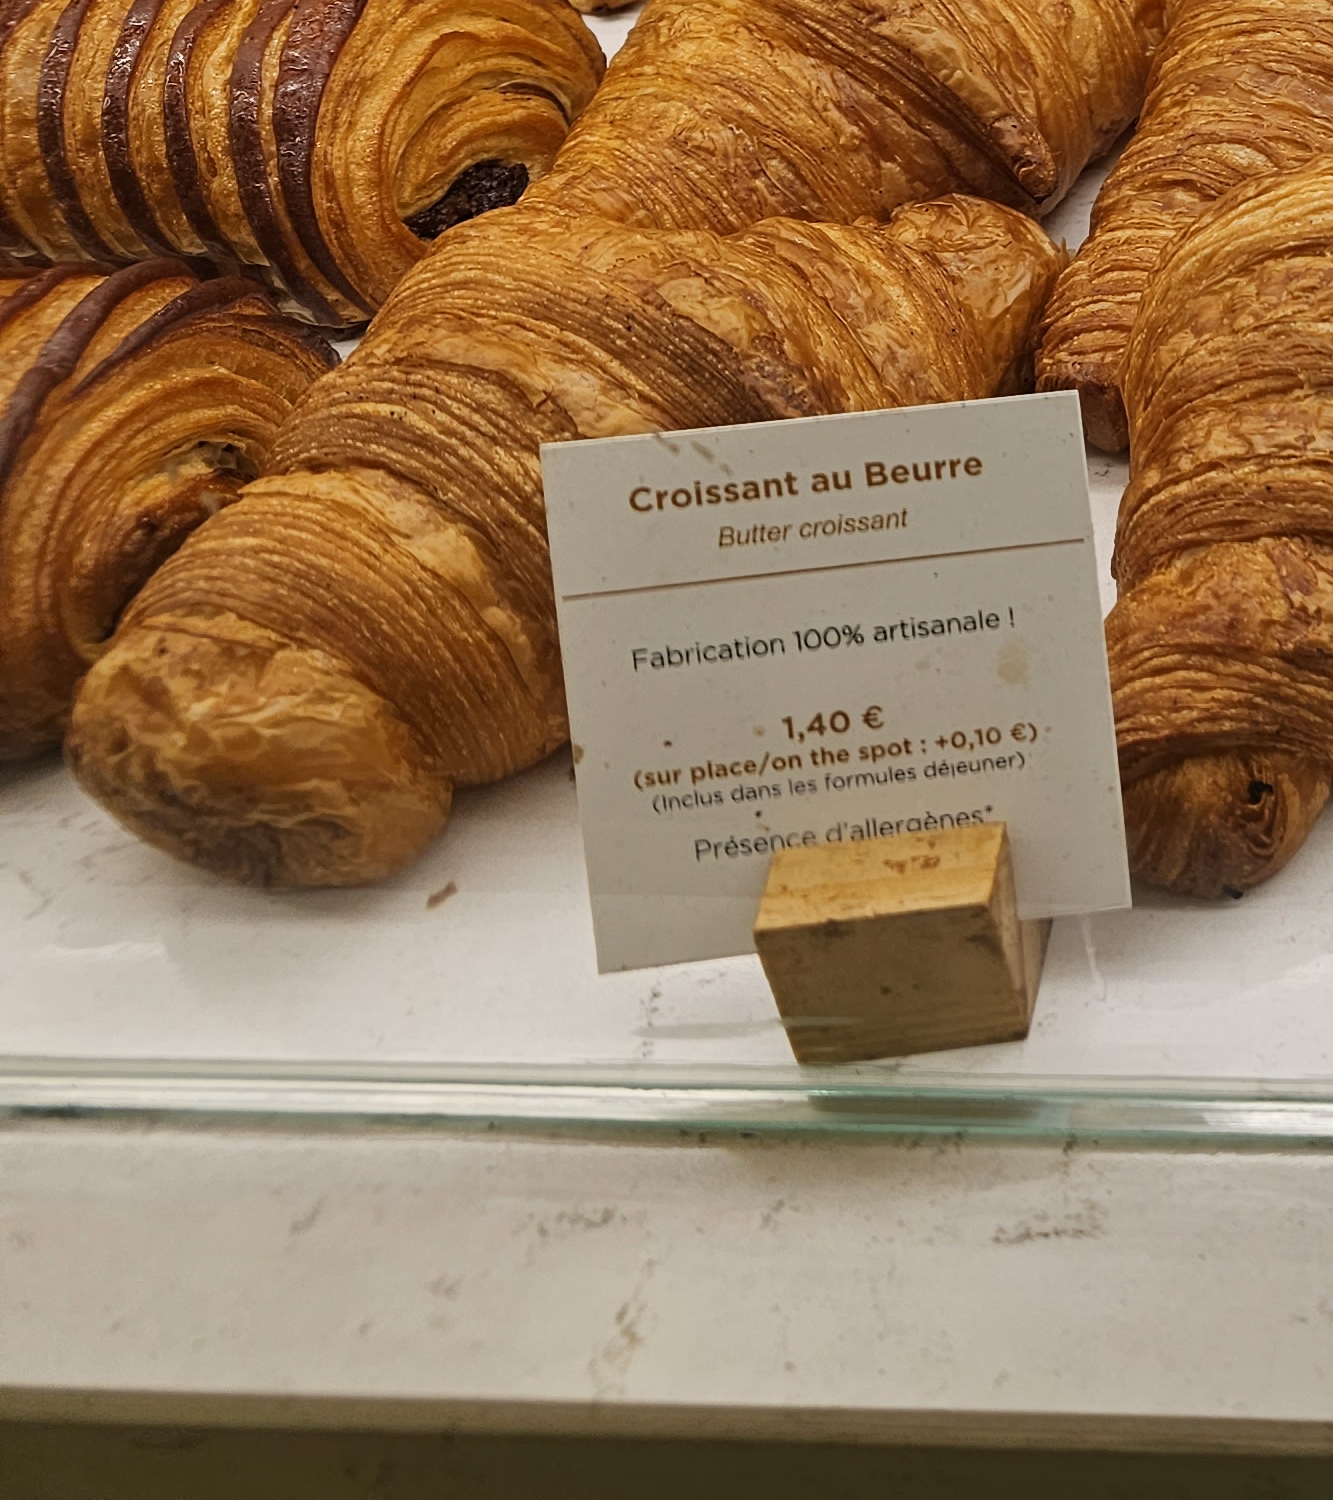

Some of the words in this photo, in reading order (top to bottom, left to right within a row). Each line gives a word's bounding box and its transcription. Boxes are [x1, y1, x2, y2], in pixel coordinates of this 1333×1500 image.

[629, 471, 799, 513] Croissant
[811, 468, 852, 494] au
[864, 455, 984, 488] Beurre
[717, 522, 792, 550] Butter
[798, 507, 909, 540] croissant
[630, 634, 786, 673] Fabrication
[792, 623, 866, 655] 100%
[872, 608, 1001, 645] artisanale
[1007, 606, 1016, 628] !
[780, 708, 852, 743] 1,40
[861, 704, 886, 730] €
[632, 766, 683, 792] (sur
[689, 750, 803, 787] place/on
[810, 744, 851, 768] the
[858, 737, 914, 765] spot
[920, 738, 928, 754] :
[933, 726, 1002, 753] +0,10
[1010, 721, 1039, 744] €)
[730, 781, 783, 802] dans
[787, 776, 818, 797] les
[824, 764, 918, 792] formules
[922, 750, 1028, 781] déjeuner)
[693, 824, 818, 864] Présence
